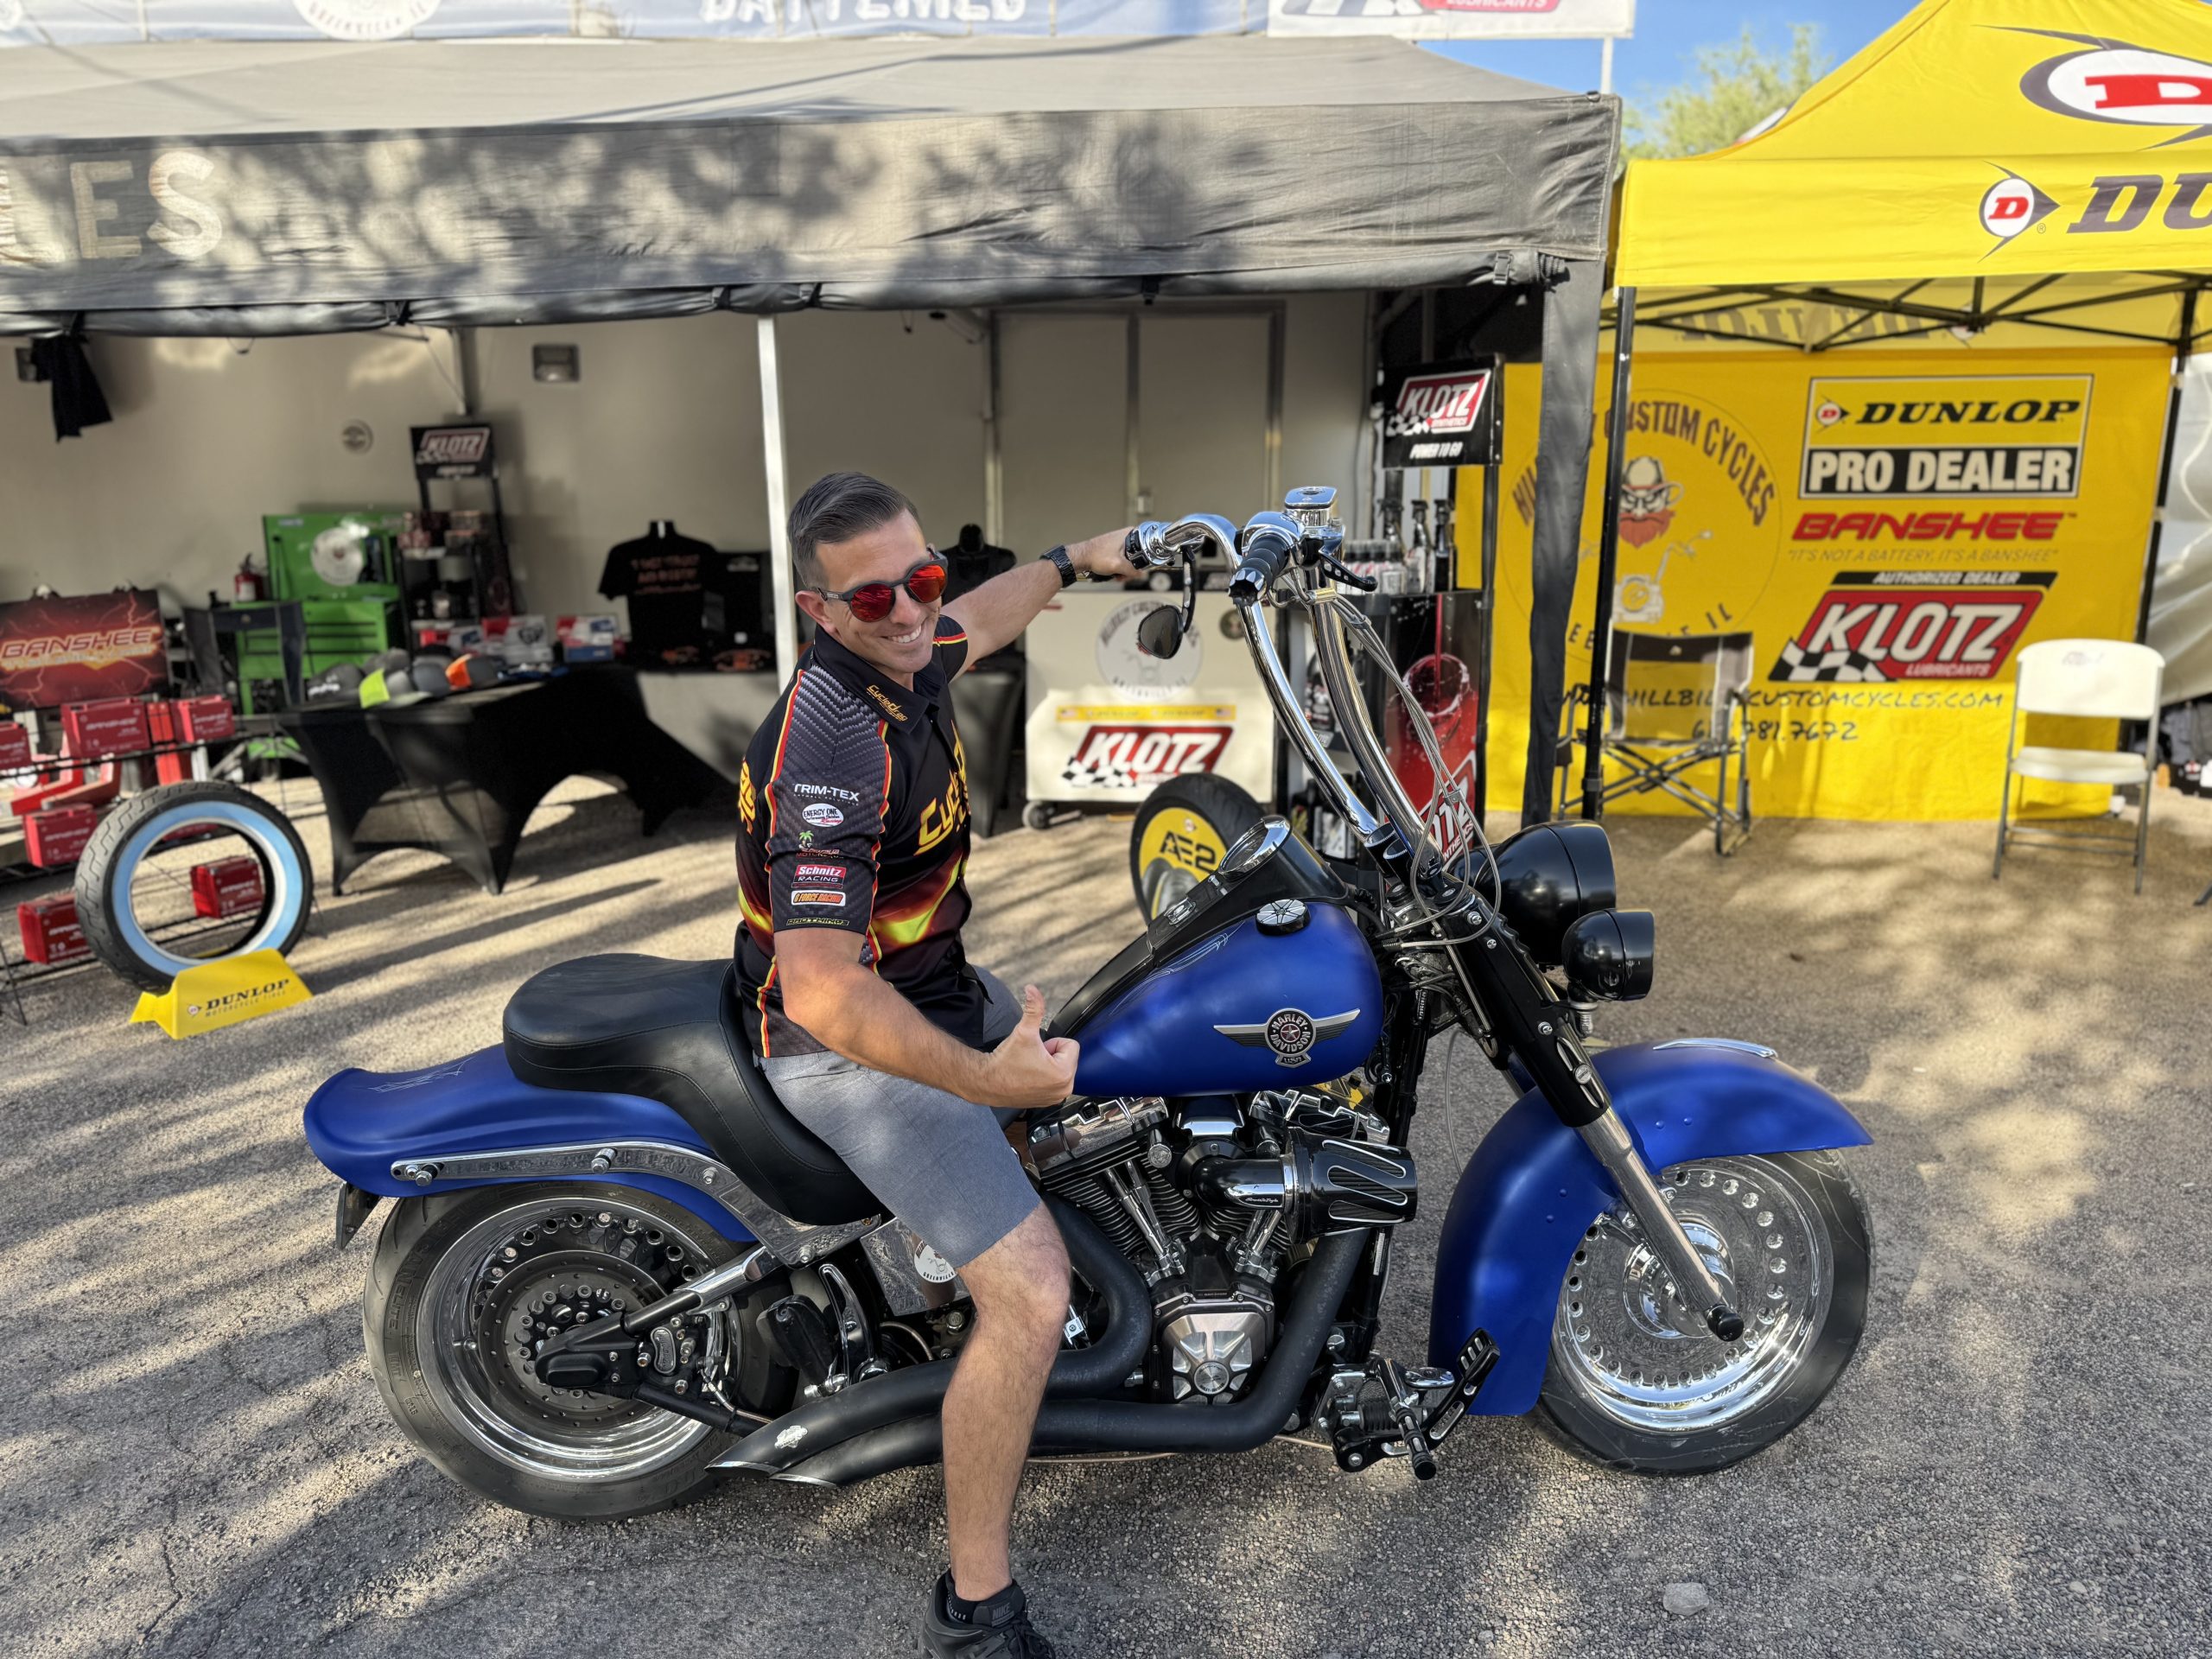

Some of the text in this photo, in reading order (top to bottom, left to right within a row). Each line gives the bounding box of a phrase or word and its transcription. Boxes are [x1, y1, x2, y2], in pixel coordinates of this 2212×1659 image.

[1402, 381, 1479, 418] KLOTZ
[1854, 400, 2081, 424] DUNLOP
[1701, 416, 1775, 527] CYCLES
[1808, 449, 2074, 493] PRO DEALER
[1791, 512, 2065, 541] BANSHEE
[1817, 549, 1849, 562] NOT
[1852, 549, 1865, 562] A
[1936, 549, 1965, 563] IT'S
[1967, 549, 1978, 562] A
[1872, 571, 2021, 585] AUTHORIZED DEALER
[1806, 602, 2024, 663] KLOTZ
[2, 630, 153, 658] BANSHEE
[1904, 663, 1991, 677] LUBRICANTS
[1082, 732, 1223, 773] KLOTZ
[793, 783, 861, 802] TRIM-TEX
[804, 809, 826, 817] ENERGY
[798, 866, 842, 876] Schnitz
[798, 893, 819, 902] FORCE
[207, 978, 289, 1010] DUNLOP
[1271, 1014, 1308, 1030] HARLEY
[1269, 1031, 1312, 1052] DAVIDSON
[992, 1602, 1011, 1621] NIKE
